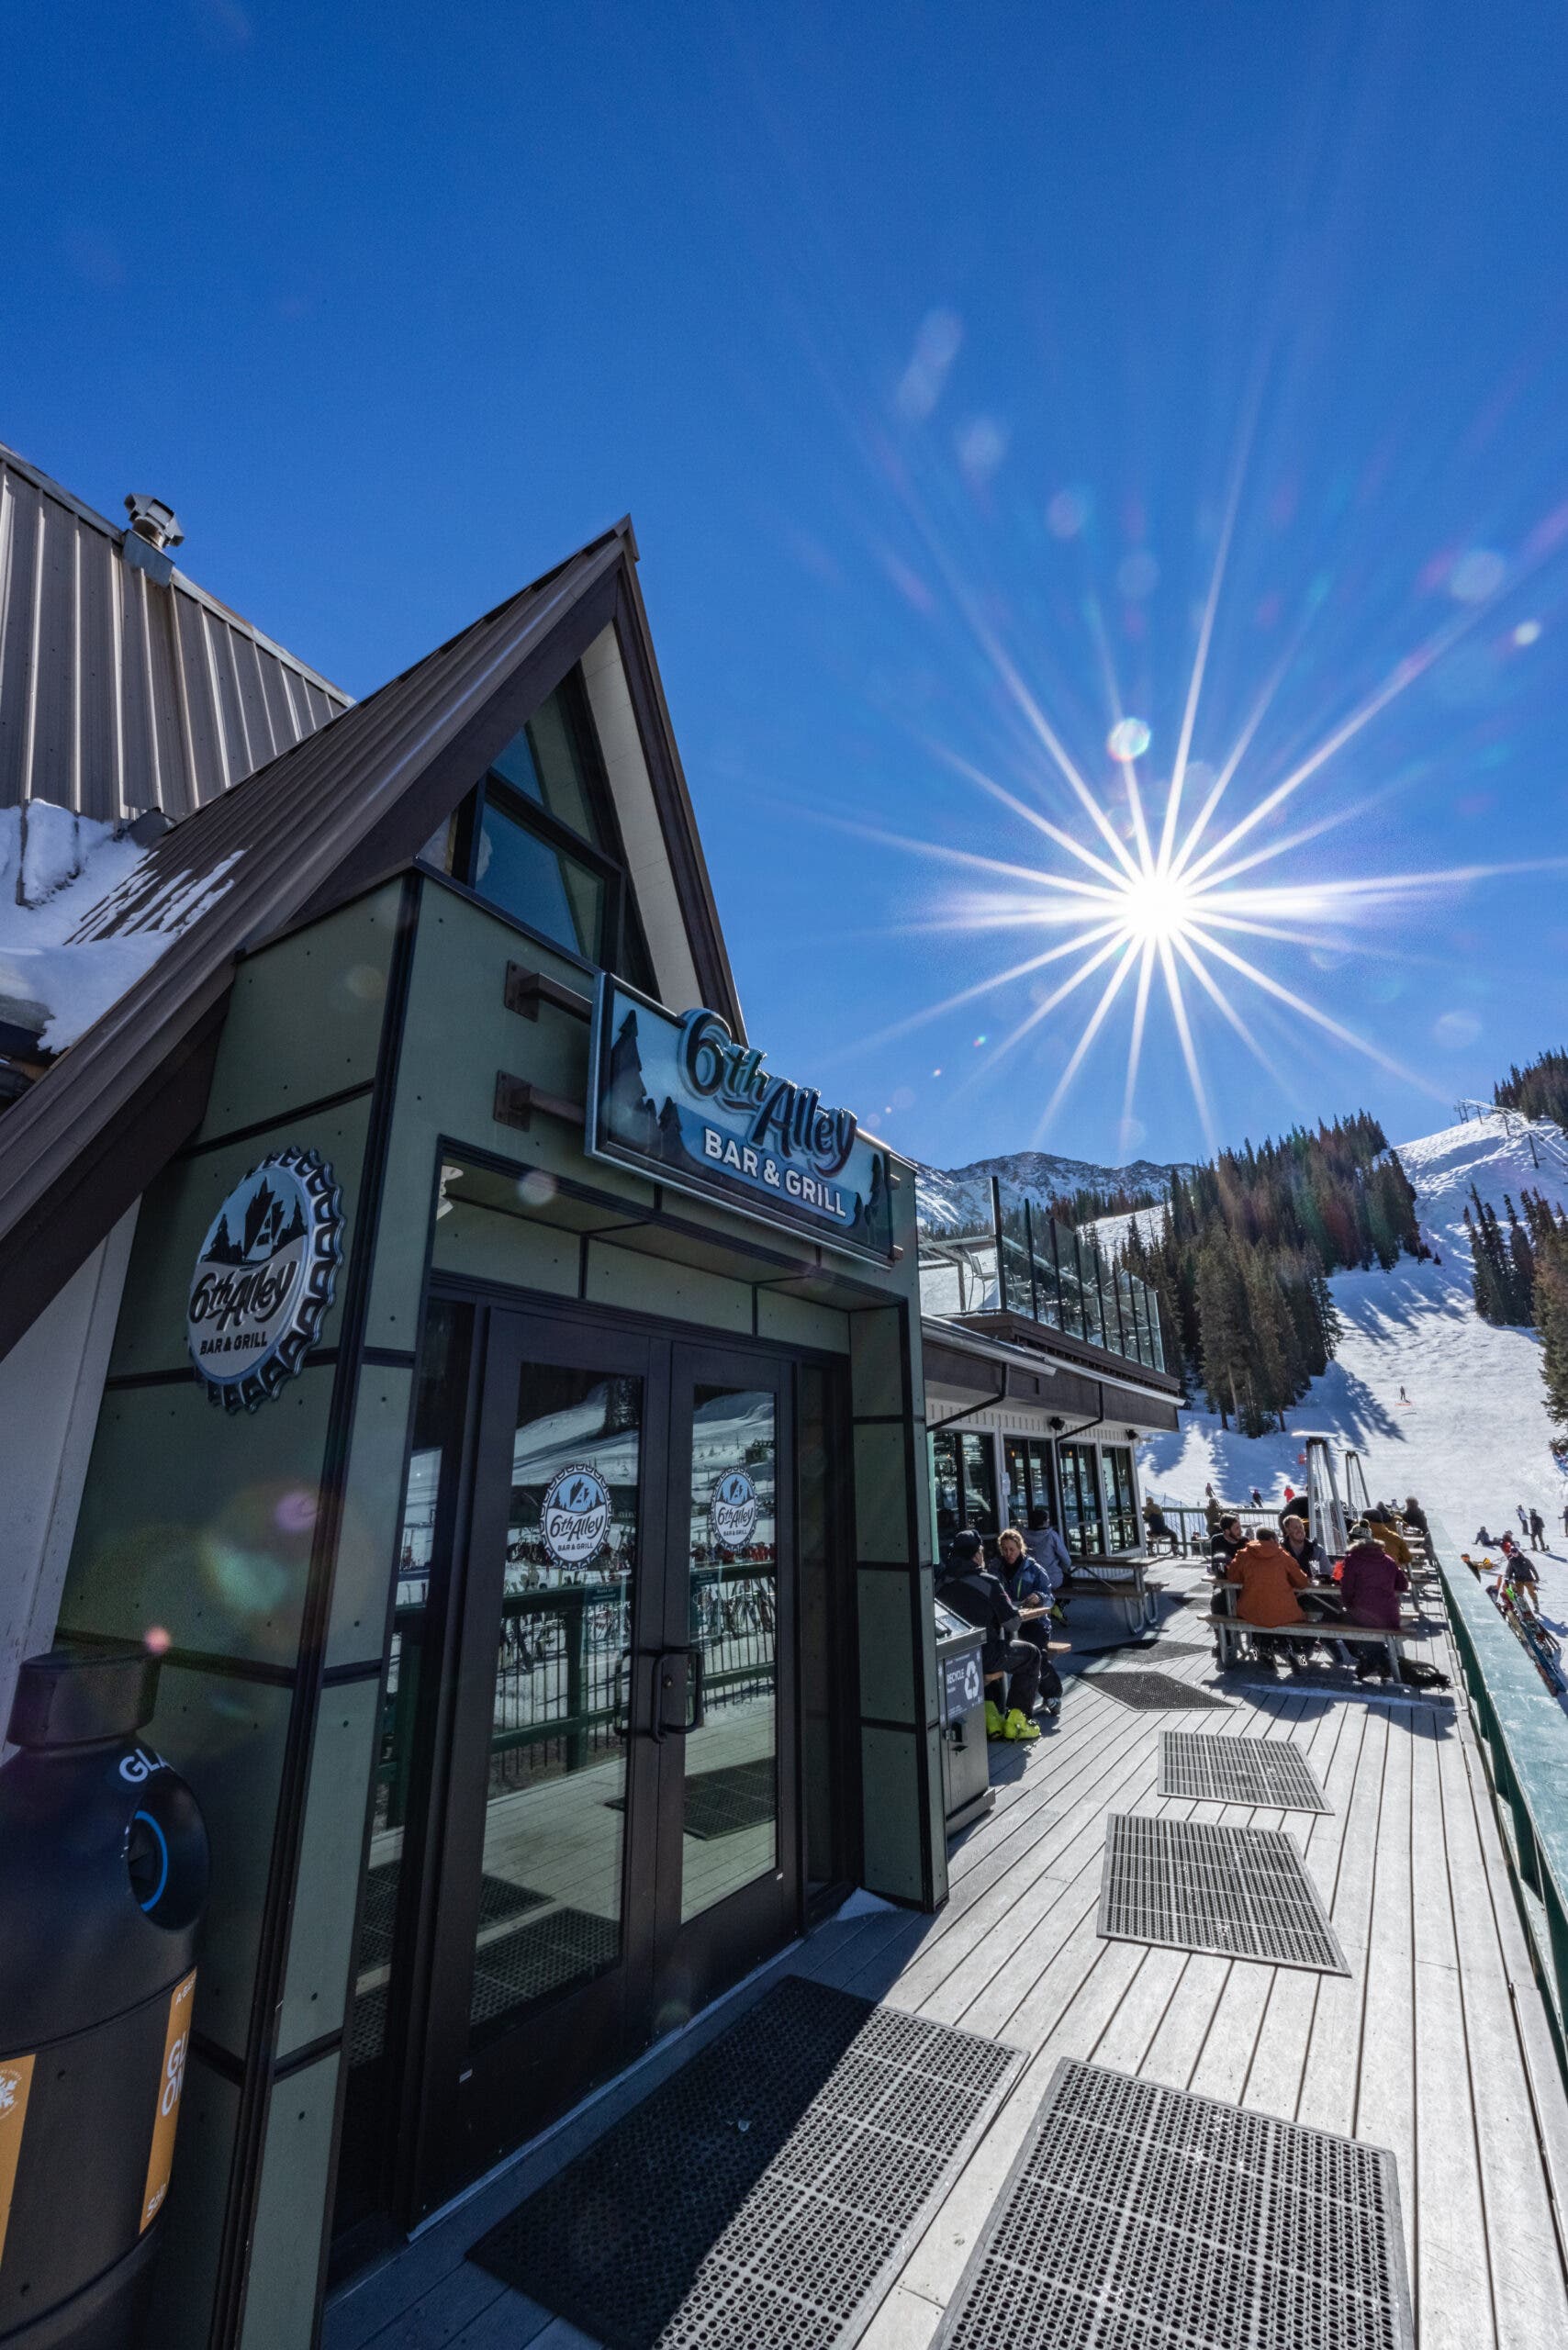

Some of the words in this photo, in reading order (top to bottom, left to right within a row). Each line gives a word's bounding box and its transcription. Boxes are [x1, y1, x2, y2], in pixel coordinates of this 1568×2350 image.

[678, 1008, 768, 1113] 6th
[747, 1077, 857, 1180] Alley
[704, 1127, 758, 1178] BAR
[763, 1158, 781, 1189] &
[785, 1169, 846, 1218] GRILL
[190, 1271, 235, 1323] 6th
[216, 1260, 298, 1331] Alley
[200, 1338, 222, 1355] BAR
[223, 1337, 232, 1352] &
[233, 1331, 268, 1349] GRILL
[550, 1515, 574, 1538] 6th
[567, 1515, 604, 1541] Alley
[718, 1506, 734, 1525] 6th
[729, 1506, 754, 1528] Alley
[557, 1544, 571, 1552] BAR
[947, 1669, 964, 1684] RECYCLE
